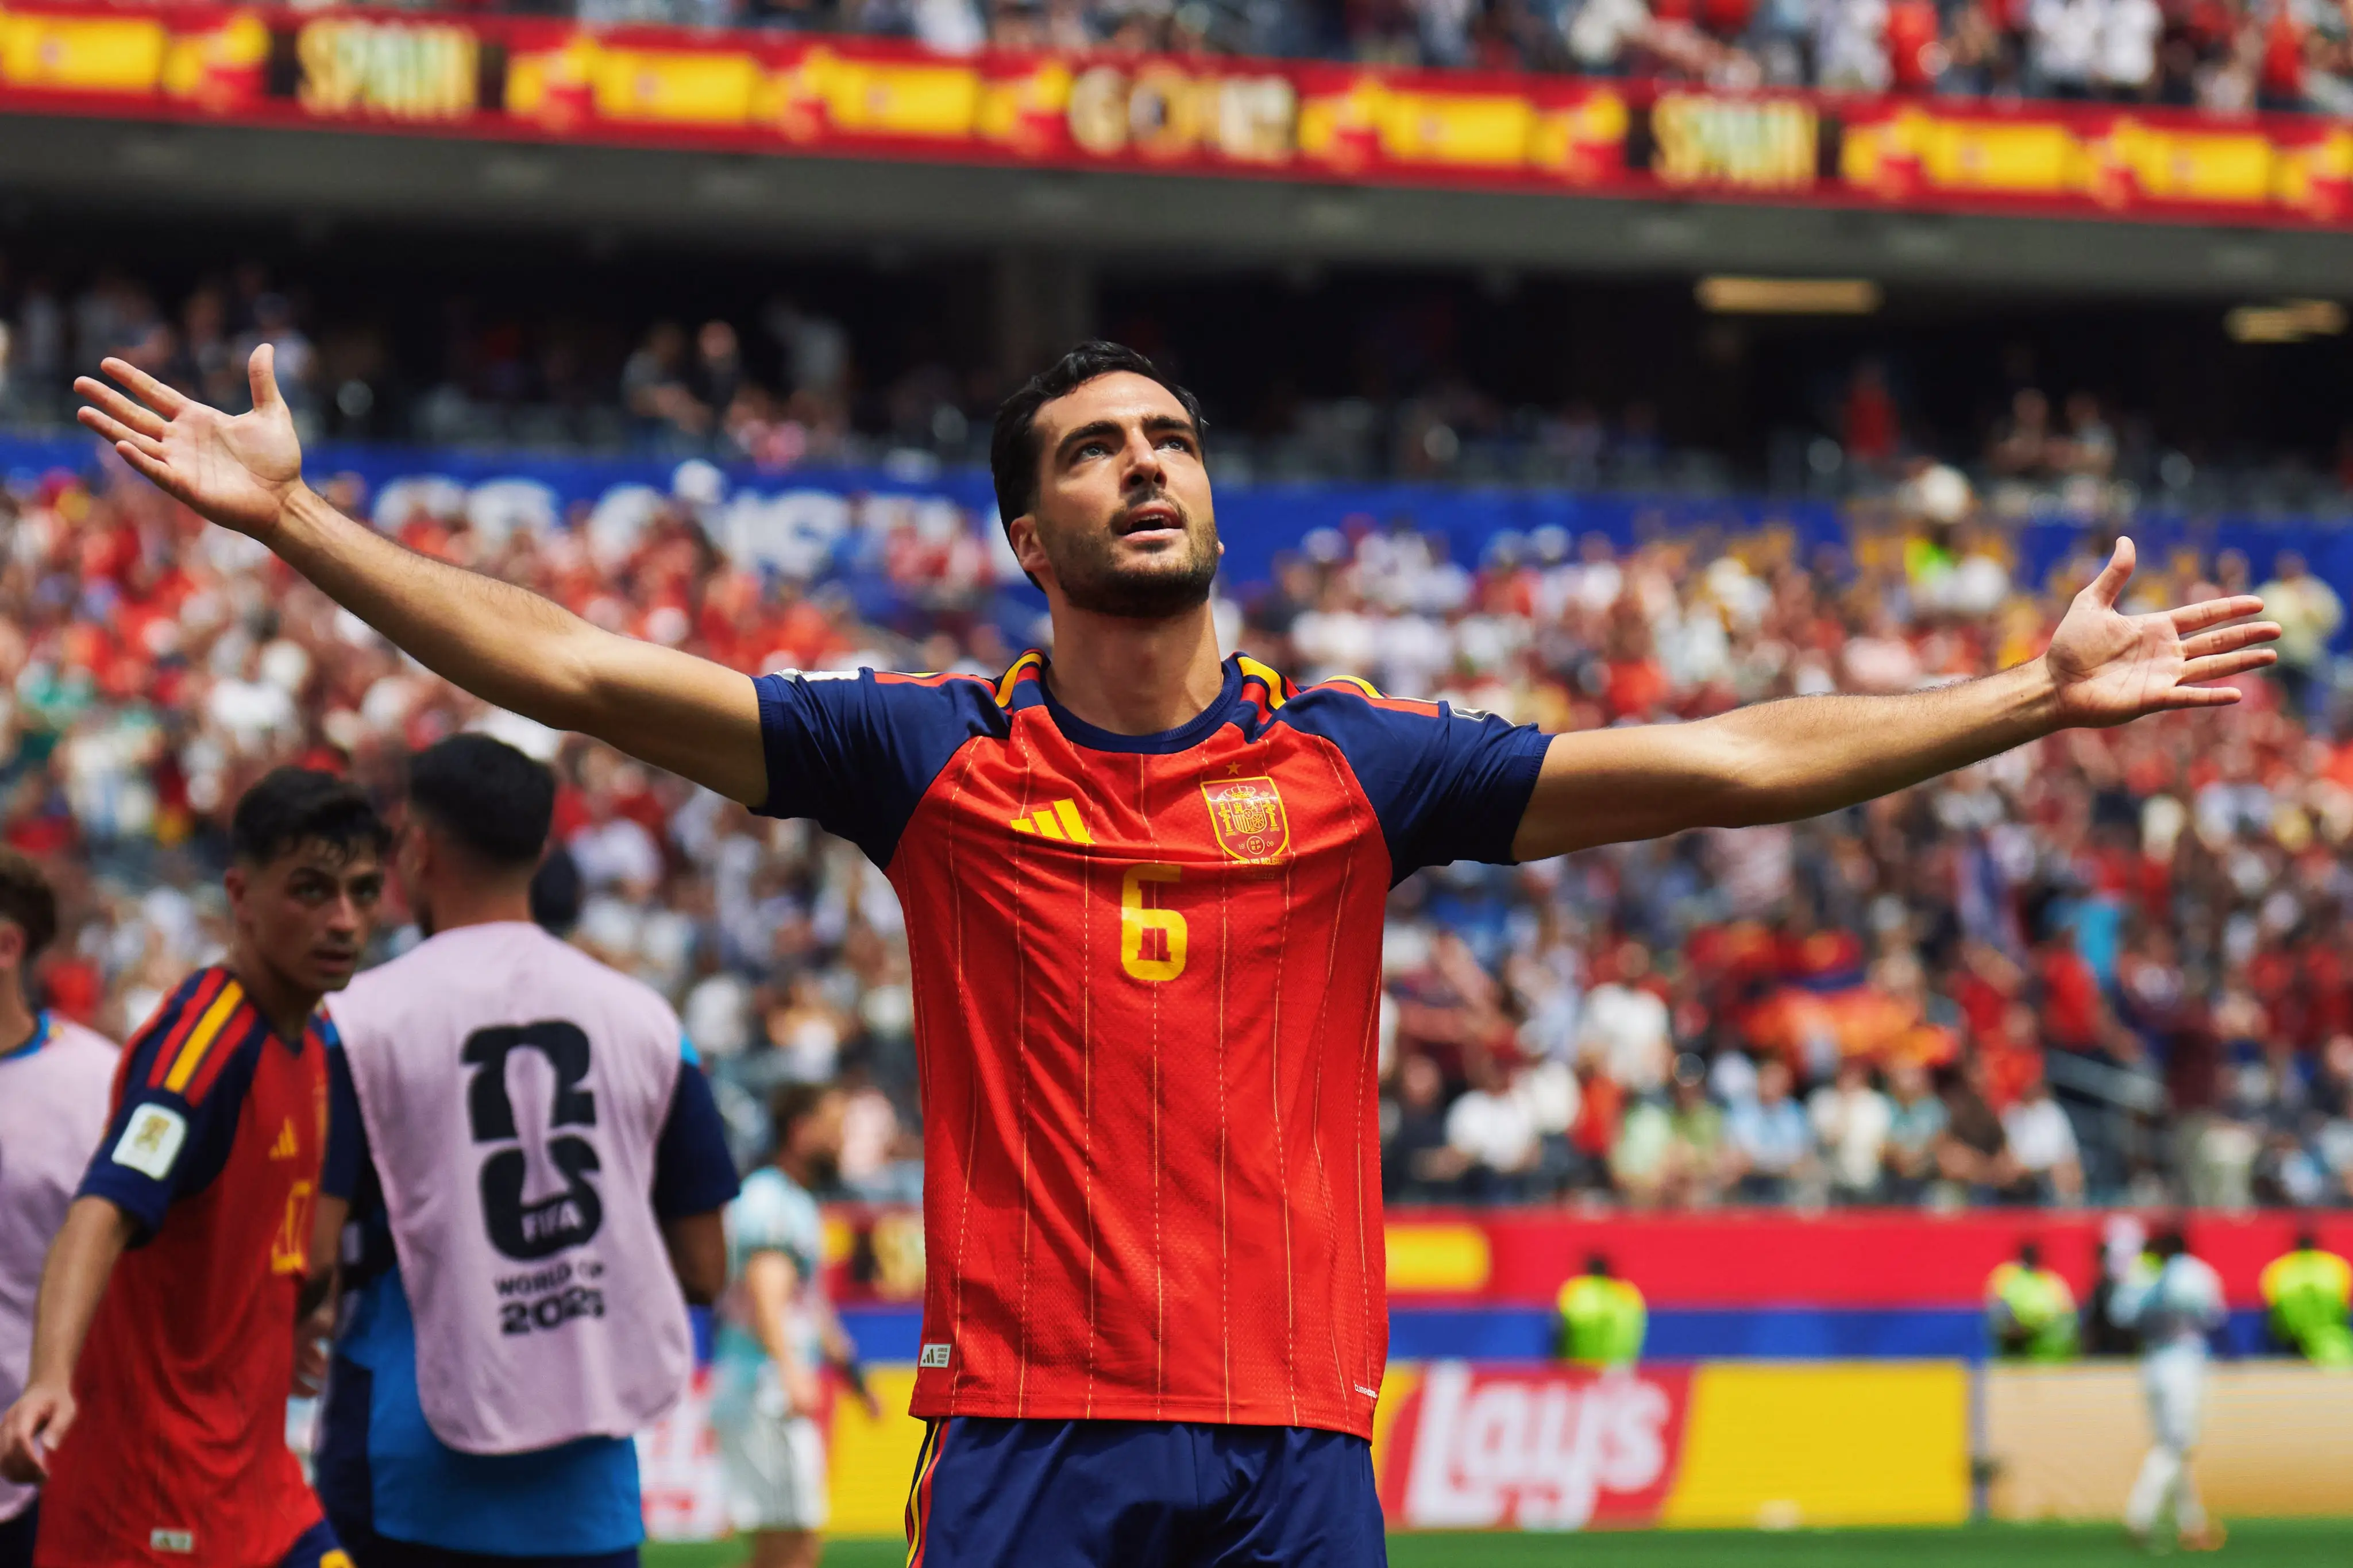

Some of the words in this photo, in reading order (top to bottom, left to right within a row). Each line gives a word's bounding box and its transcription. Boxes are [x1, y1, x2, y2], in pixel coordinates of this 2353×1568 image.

[1121, 863, 1187, 982] 6
[521, 1200, 585, 1243] FIFA
[493, 1261, 573, 1295] WORLD
